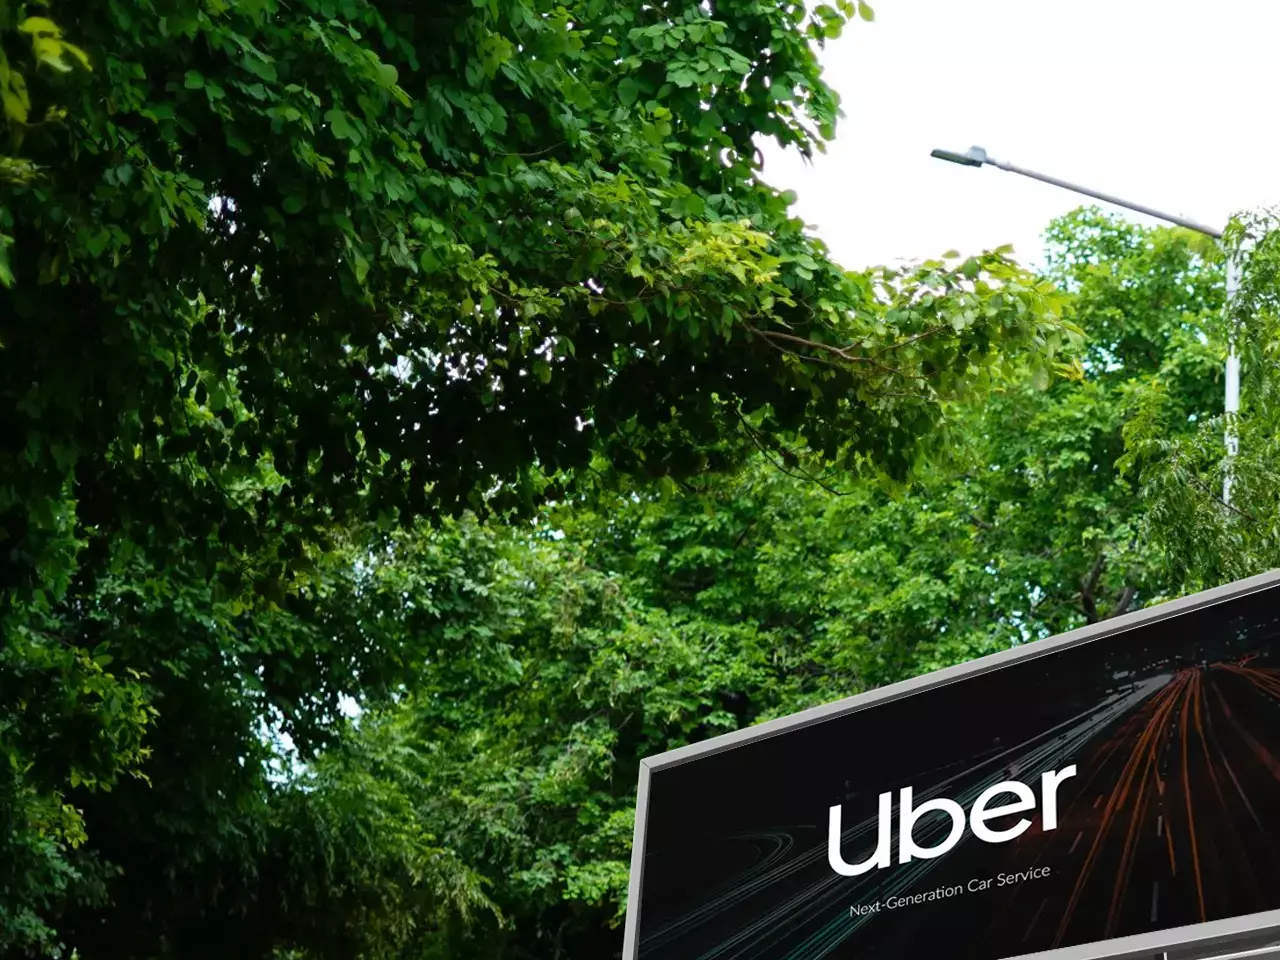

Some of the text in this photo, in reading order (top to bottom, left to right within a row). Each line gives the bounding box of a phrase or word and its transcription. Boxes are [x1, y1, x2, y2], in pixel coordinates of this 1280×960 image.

[828, 764, 1077, 877] Uber
[849, 866, 1051, 917] Next-Generation Car Service
